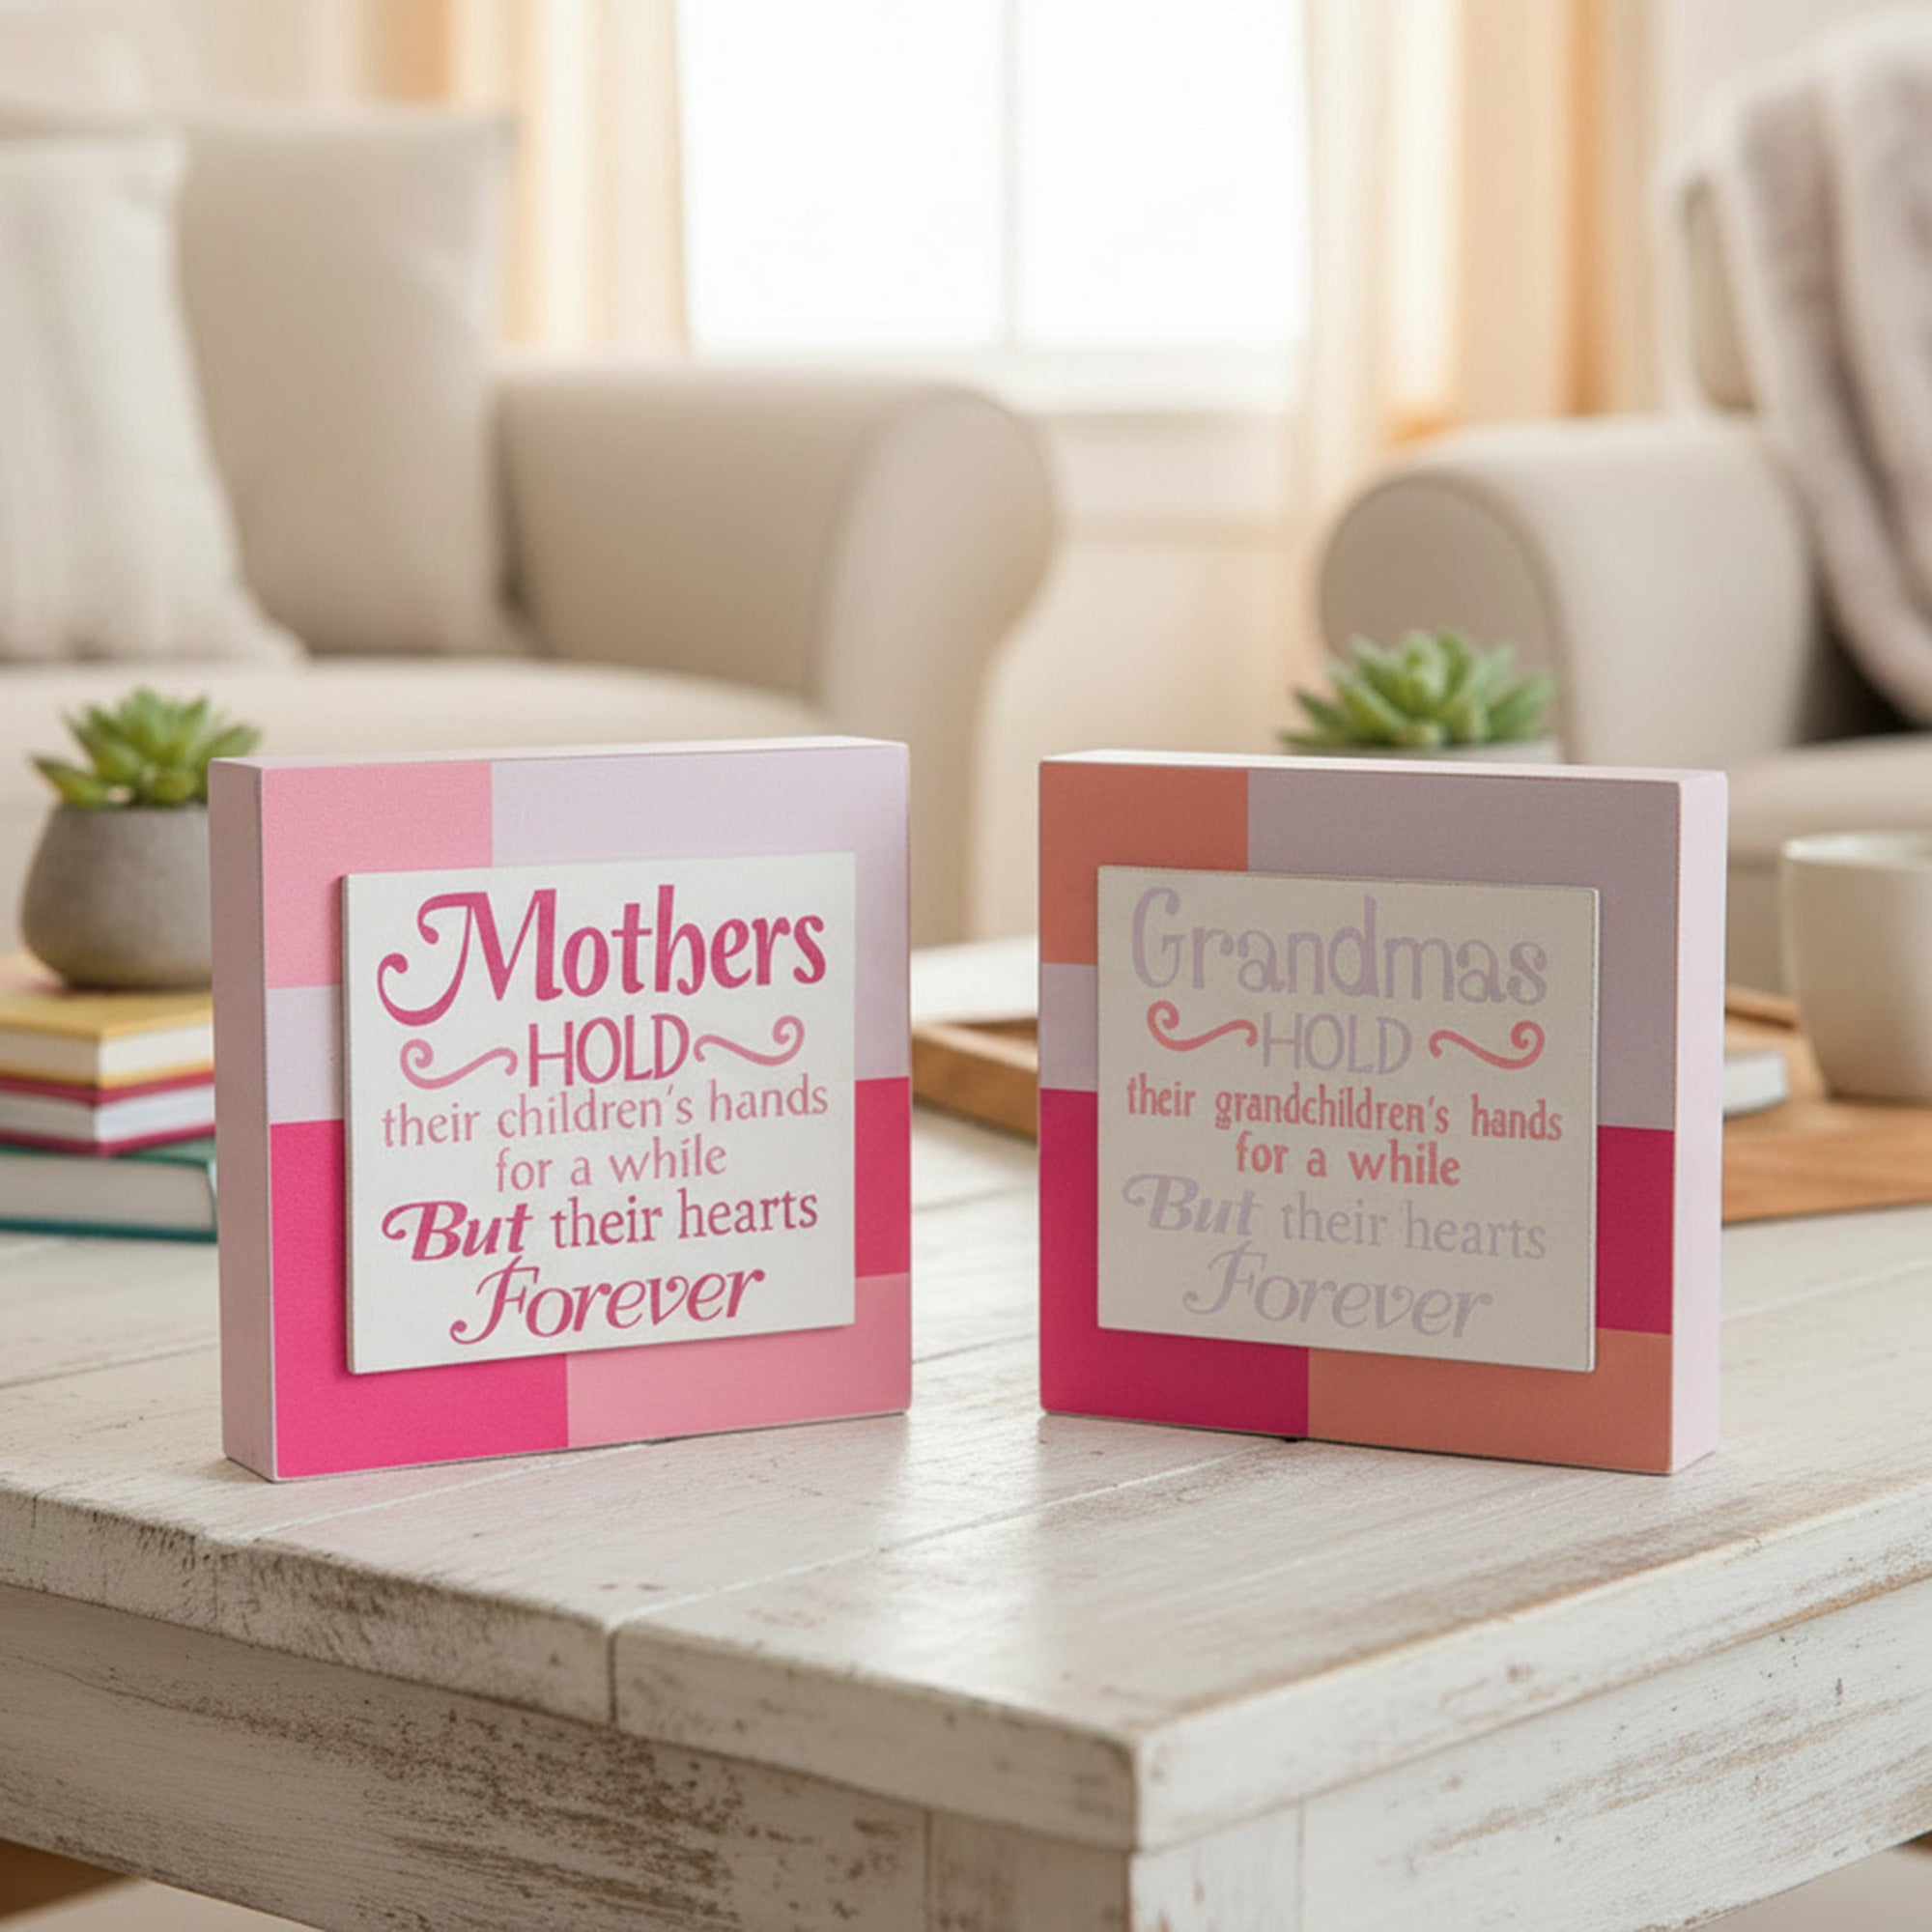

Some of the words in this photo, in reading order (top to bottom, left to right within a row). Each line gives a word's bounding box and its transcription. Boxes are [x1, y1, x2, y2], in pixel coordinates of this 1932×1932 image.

[377, 884, 827, 1027] Mothers
[1132, 887, 1547, 1006] Grandmas
[528, 1012, 690, 1088] HOLD
[1262, 1011, 1412, 1075] HOLD
[382, 1102, 480, 1148] their
[497, 1084, 693, 1139] children's
[708, 1073, 828, 1122] hands
[1126, 1073, 1196, 1117] their
[1215, 1082, 1449, 1133] grandchildren's
[1470, 1094, 1563, 1141] hands
[497, 1147, 553, 1193] for
[571, 1155, 591, 1185] a
[609, 1134, 726, 1183] while
[1236, 1130, 1289, 1175] for
[1306, 1147, 1327, 1178] a
[1349, 1139, 1461, 1186] while
[381, 1200, 533, 1262] But
[551, 1196, 663, 1249] their
[677, 1187, 818, 1239] hearts
[1122, 1173, 1262, 1236] But
[1281, 1191, 1388, 1246] their
[1405, 1200, 1547, 1260] hearts
[449, 1255, 765, 1345] Forever
[1182, 1238, 1493, 1338] Forever
